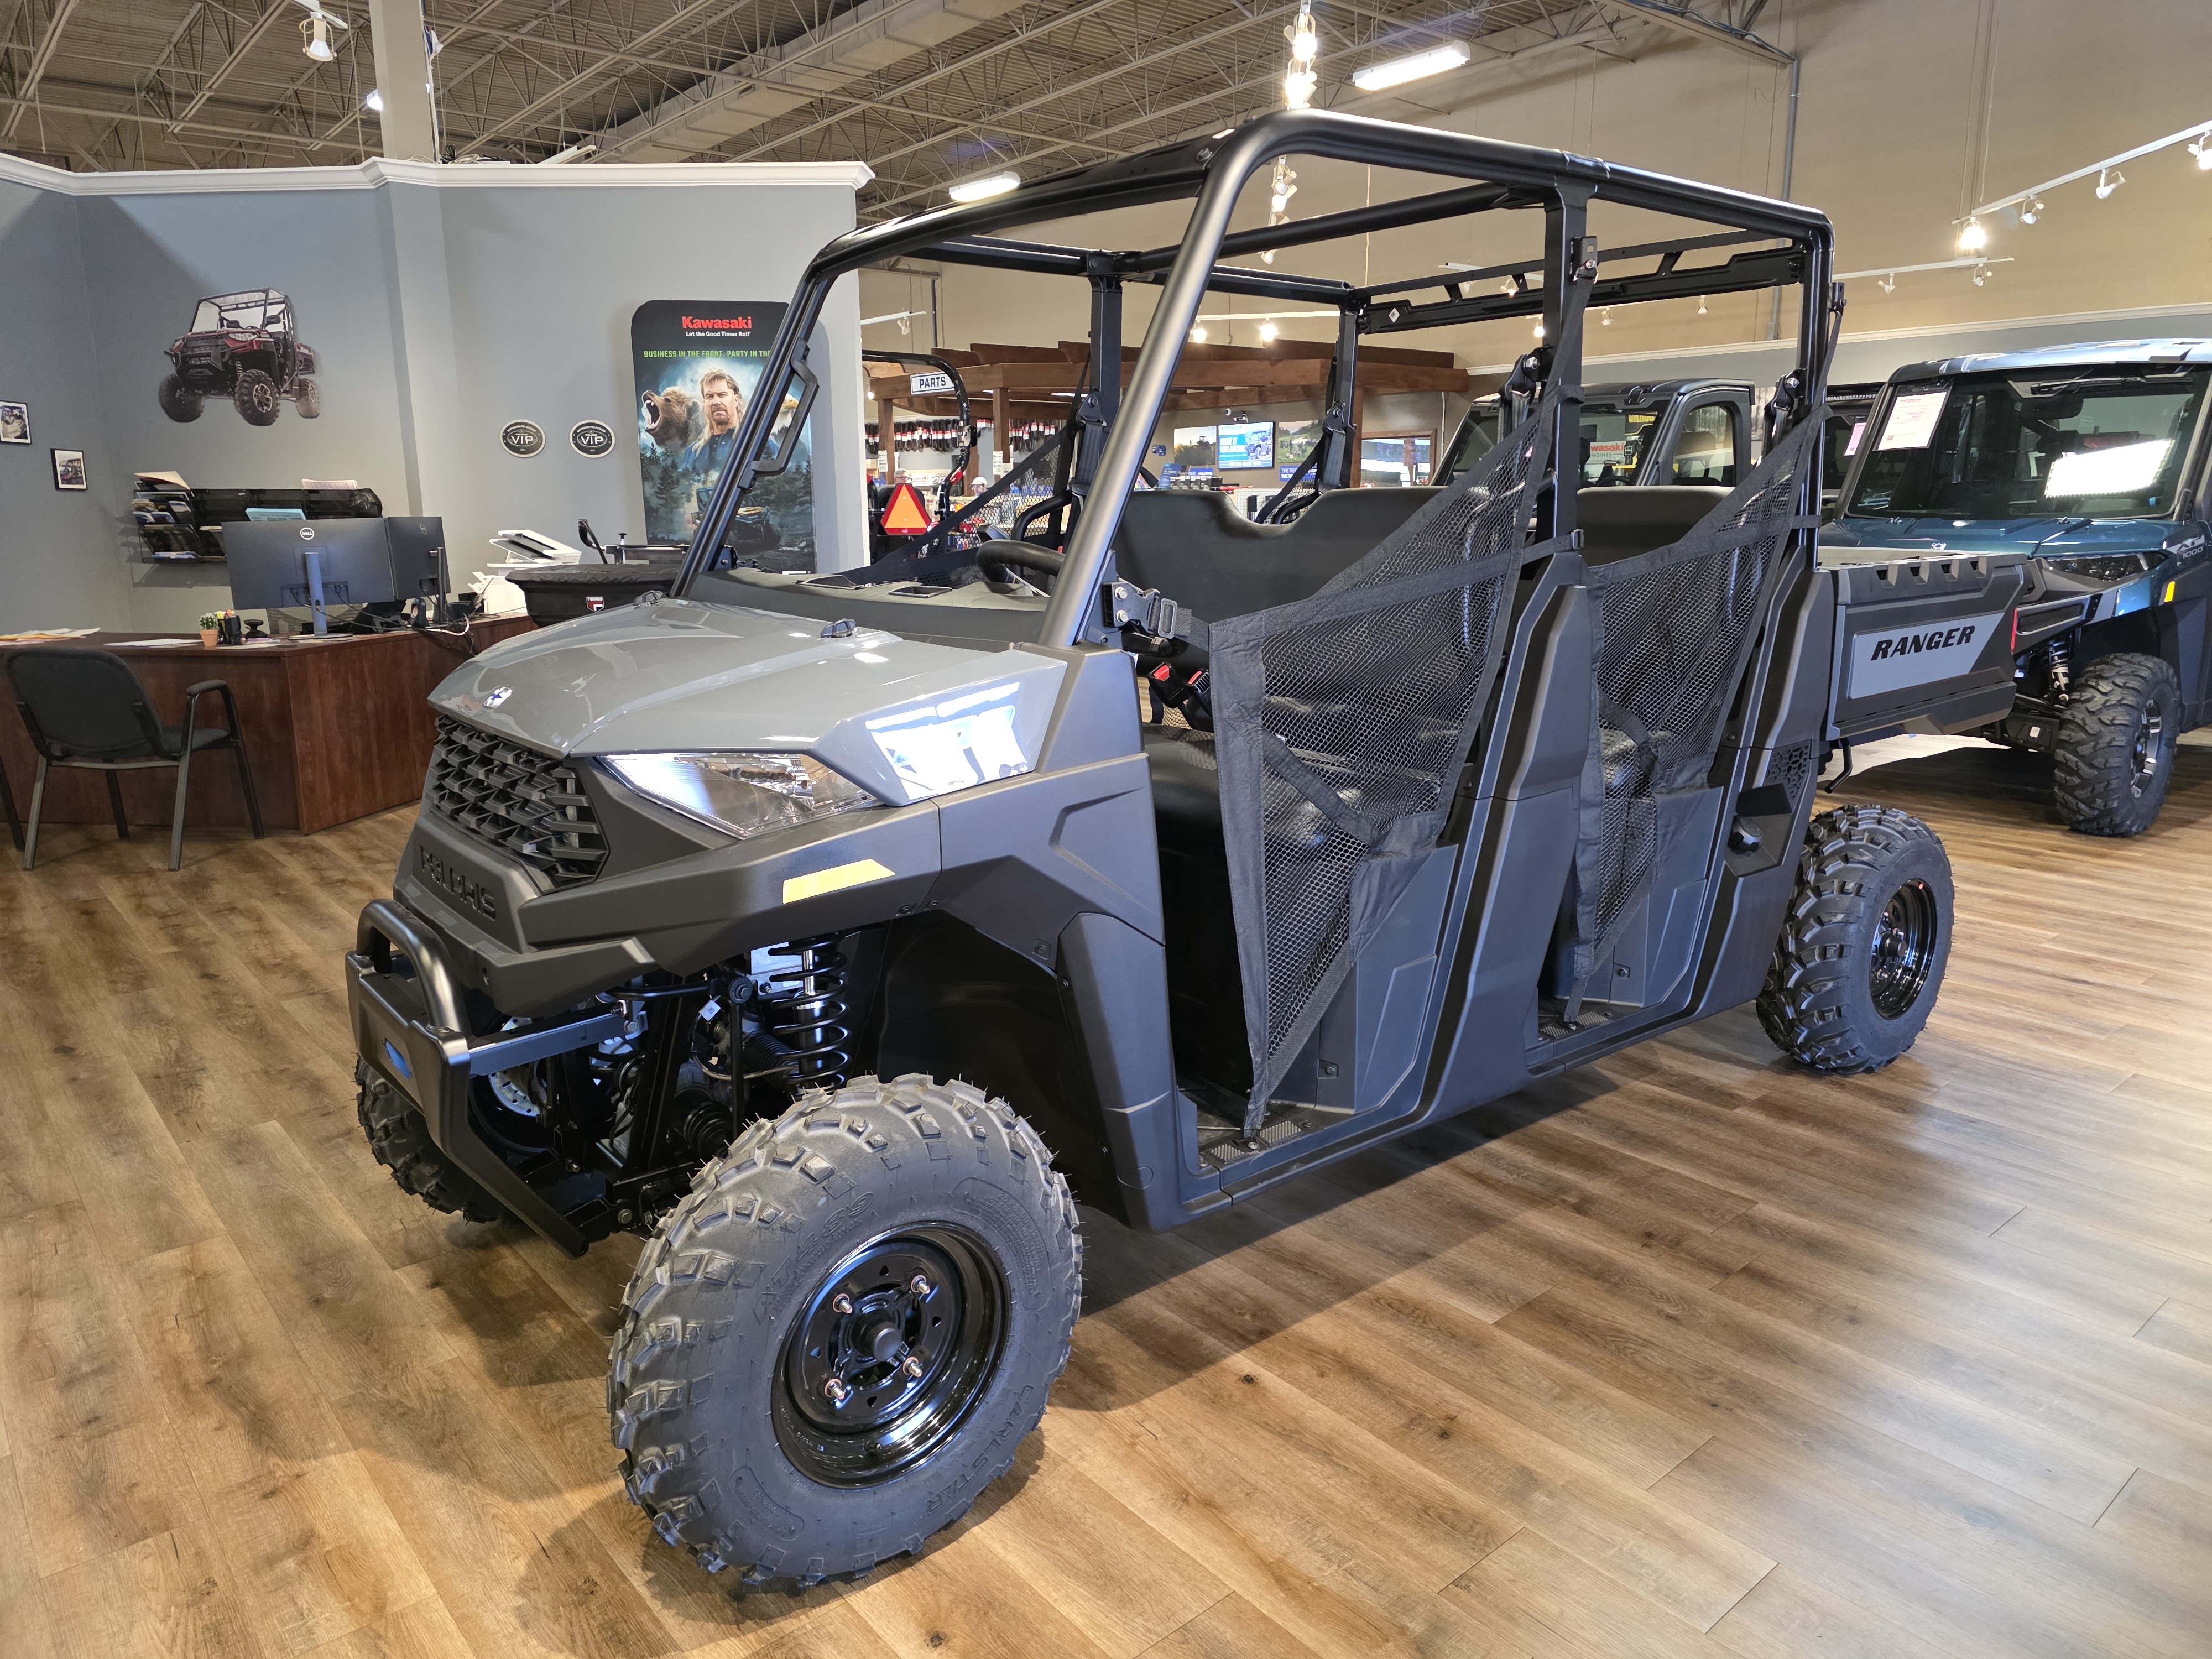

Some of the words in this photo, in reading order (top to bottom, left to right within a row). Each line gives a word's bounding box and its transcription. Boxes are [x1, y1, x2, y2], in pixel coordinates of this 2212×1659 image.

[682, 316, 752, 329] Kawasaki
[919, 376, 946, 389] PARTS
[510, 435, 534, 444] VIP
[581, 436, 604, 445] VIP
[2182, 546, 2204, 559] 1000
[1870, 625, 1976, 661] RANGER
[420, 844, 497, 922] POLARIS
[925, 1383, 1035, 1516] CARLSTAR
